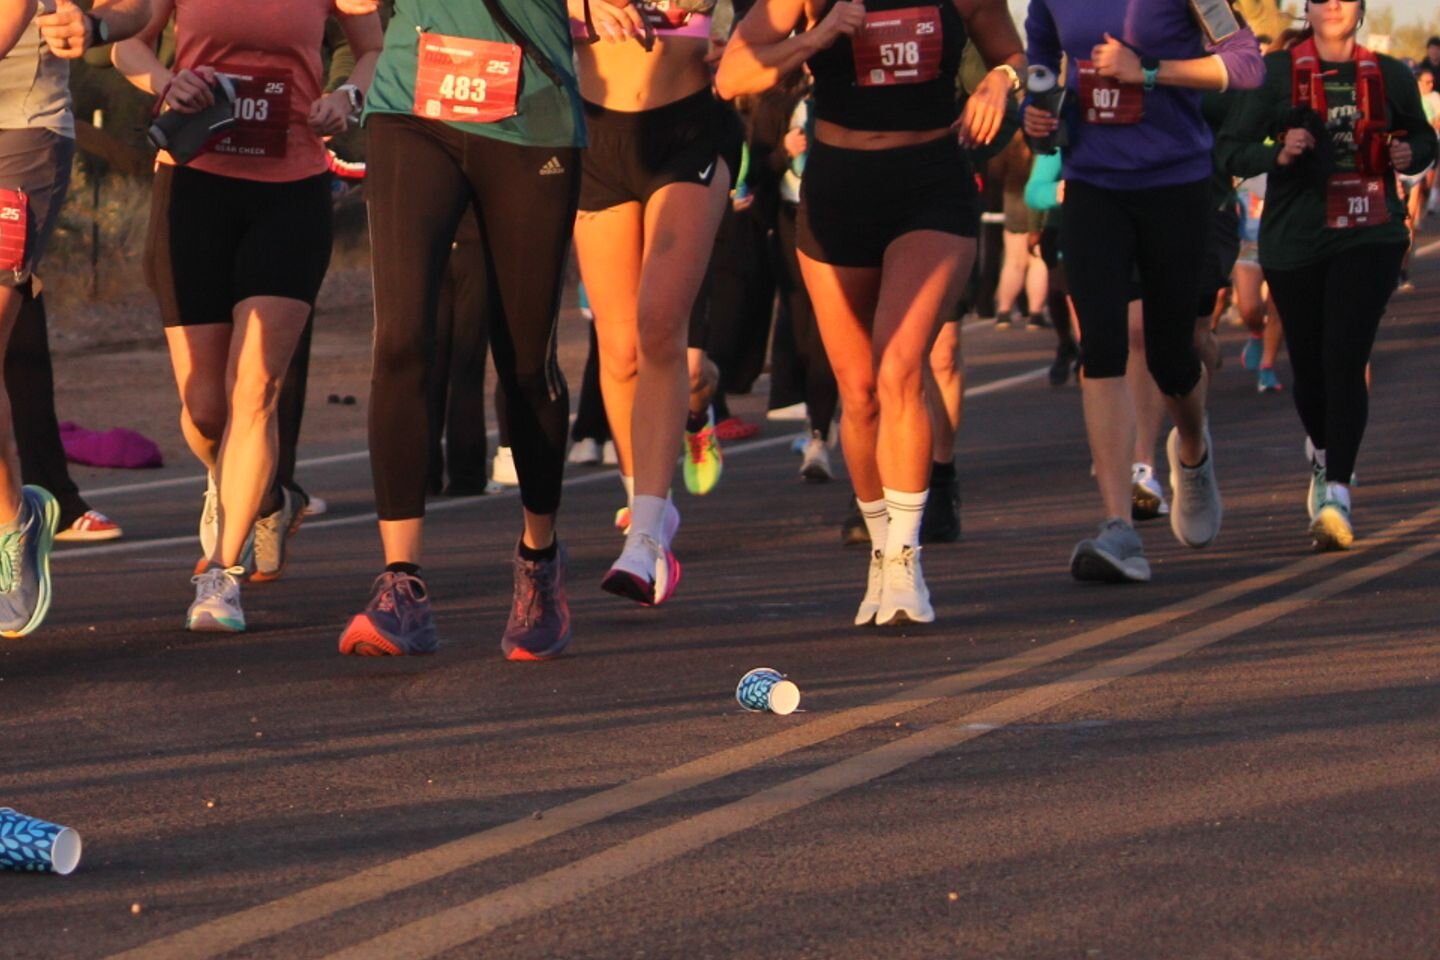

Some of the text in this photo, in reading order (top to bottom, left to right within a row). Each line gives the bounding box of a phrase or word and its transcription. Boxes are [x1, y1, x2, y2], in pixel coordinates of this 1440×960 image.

[915, 21, 935, 35] 25
[880, 41, 920, 66] 578
[486, 60, 510, 75] 25
[264, 82, 285, 94] 25
[439, 73, 487, 102] 483
[233, 97, 269, 120] 103
[238, 146, 266, 155] CHECK
[1347, 196, 1370, 215] 731
[0, 206, 21, 221] 25
